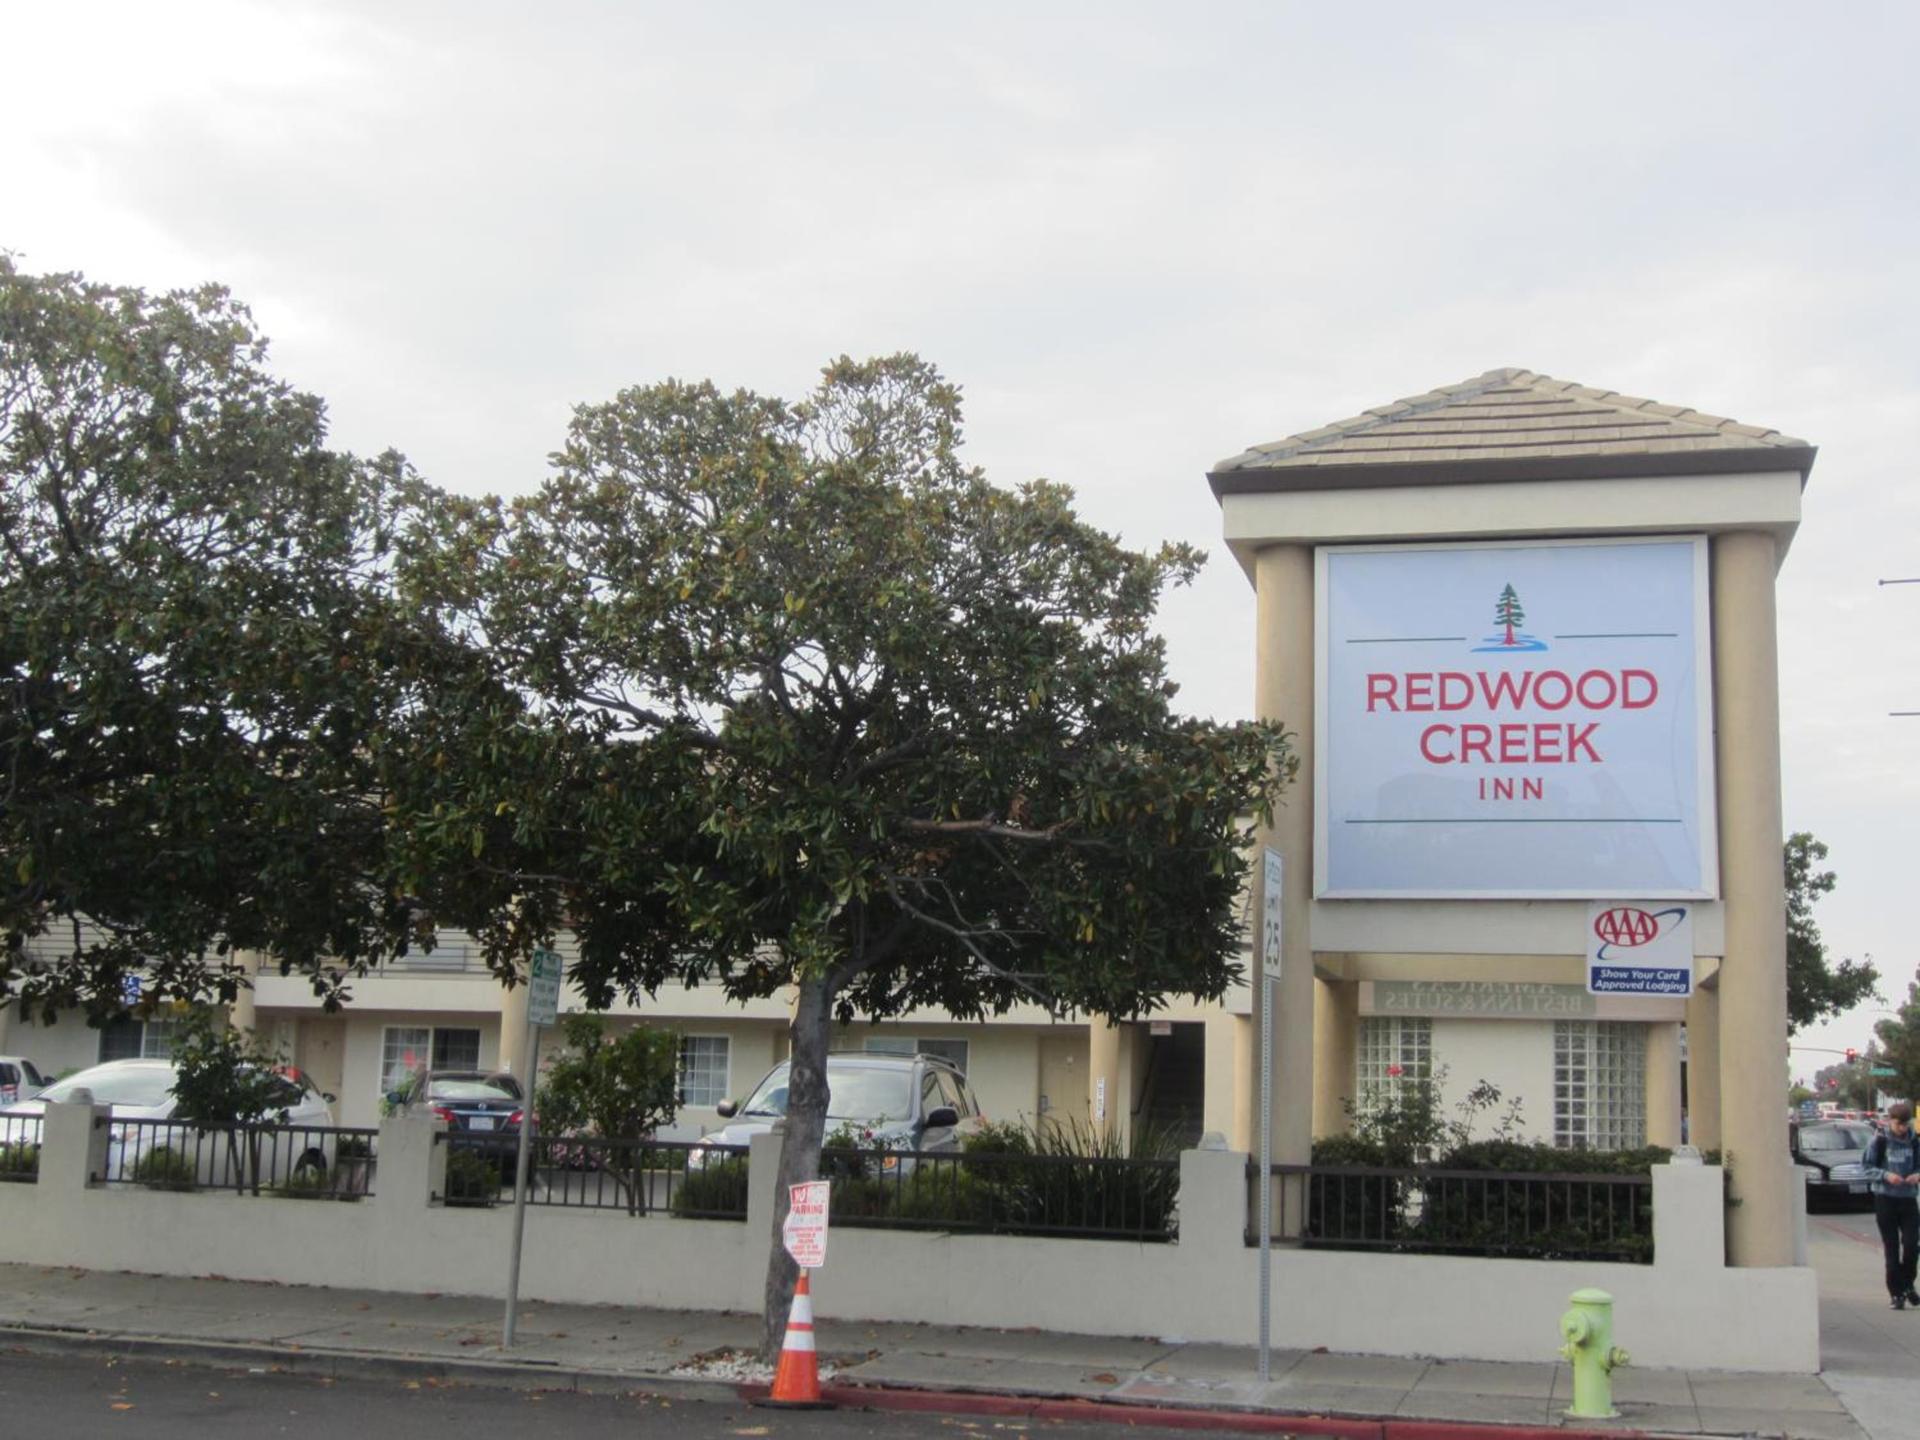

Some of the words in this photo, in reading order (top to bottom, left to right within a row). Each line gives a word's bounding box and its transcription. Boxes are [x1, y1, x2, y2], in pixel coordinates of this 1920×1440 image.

[1366, 669, 1659, 713] REDWOOD
[1419, 722, 1603, 765] CREEK
[1478, 776, 1544, 800] INN
[1266, 919, 1280, 966] 25
[1599, 908, 1653, 946] AAA
[1594, 979, 1645, 991] Approved
[1645, 981, 1687, 993] Lodging
[1600, 968, 1630, 979] Show
[1631, 970, 1655, 980] Your
[1656, 970, 1681, 981] Card
